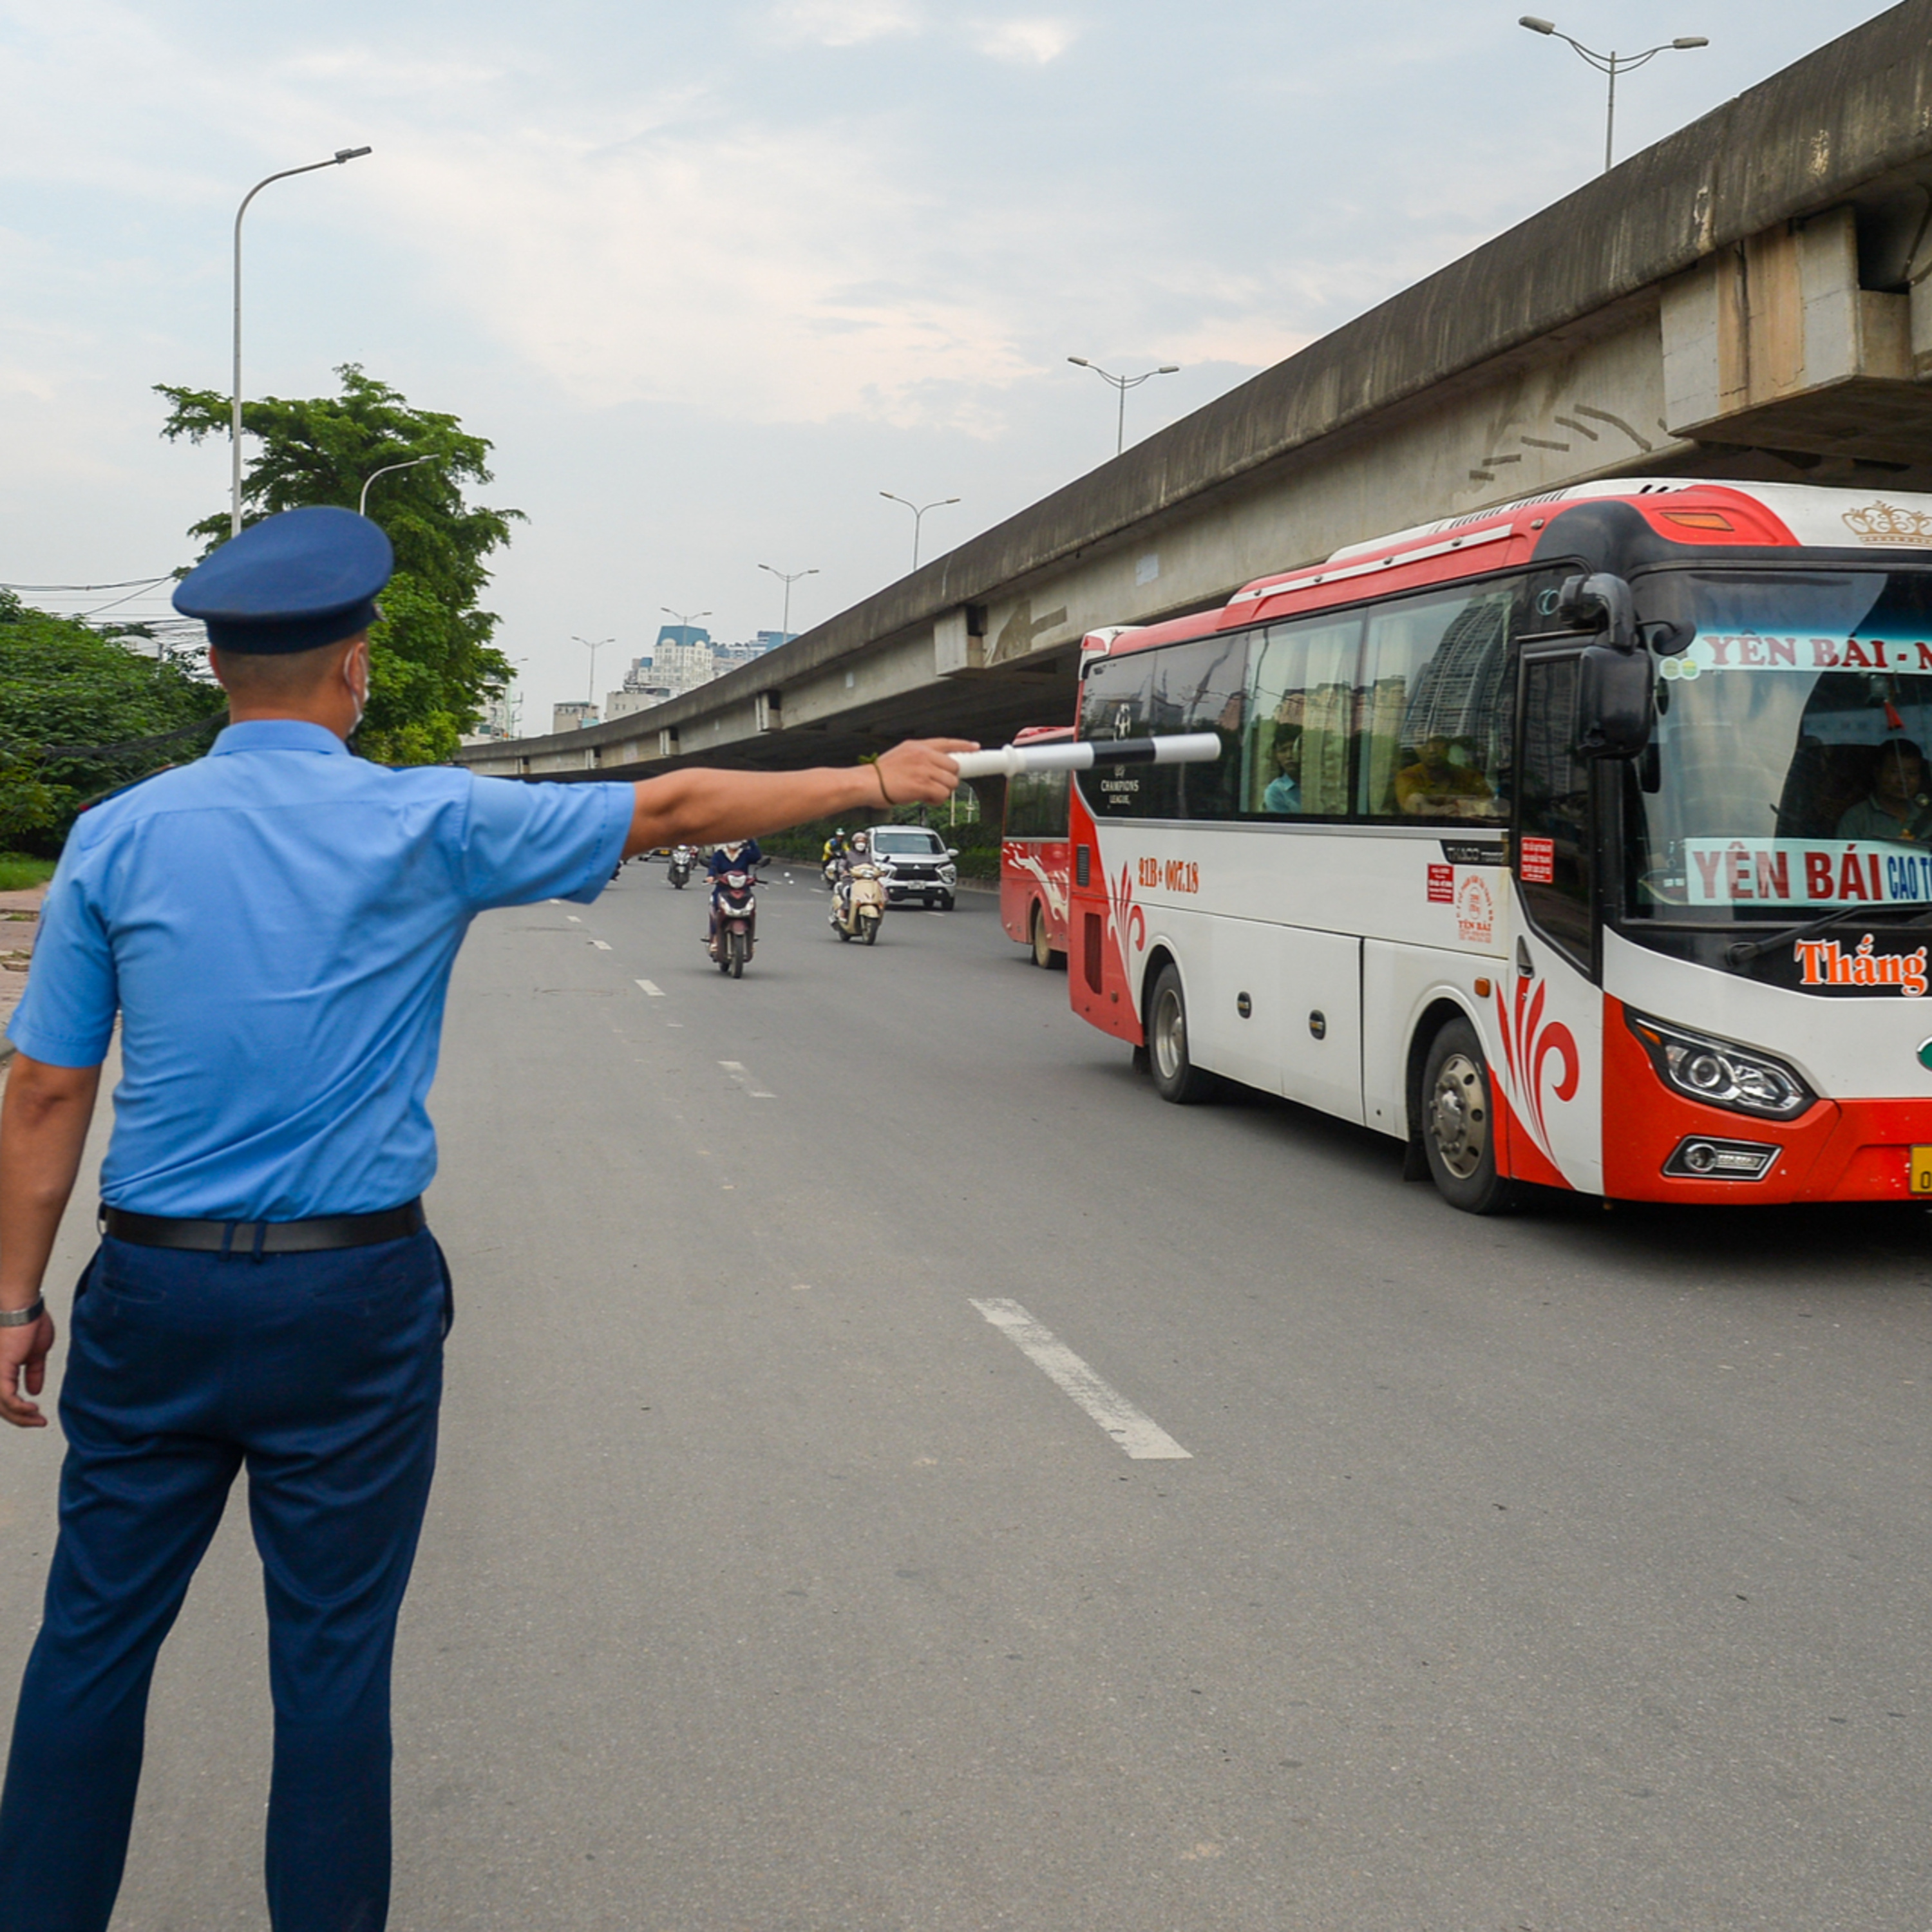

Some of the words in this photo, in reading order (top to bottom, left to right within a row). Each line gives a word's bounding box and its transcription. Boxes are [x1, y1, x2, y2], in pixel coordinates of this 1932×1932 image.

[1703, 629, 1796, 666] YÊN
[1809, 632, 1888, 668] BÁI
[1101, 779, 1139, 792] CHAMPIONS
[1692, 841, 1790, 899] YÊN
[1804, 844, 1883, 901] BÁI
[1888, 856, 1918, 900] CAO
[1794, 933, 1928, 997] Thắng
